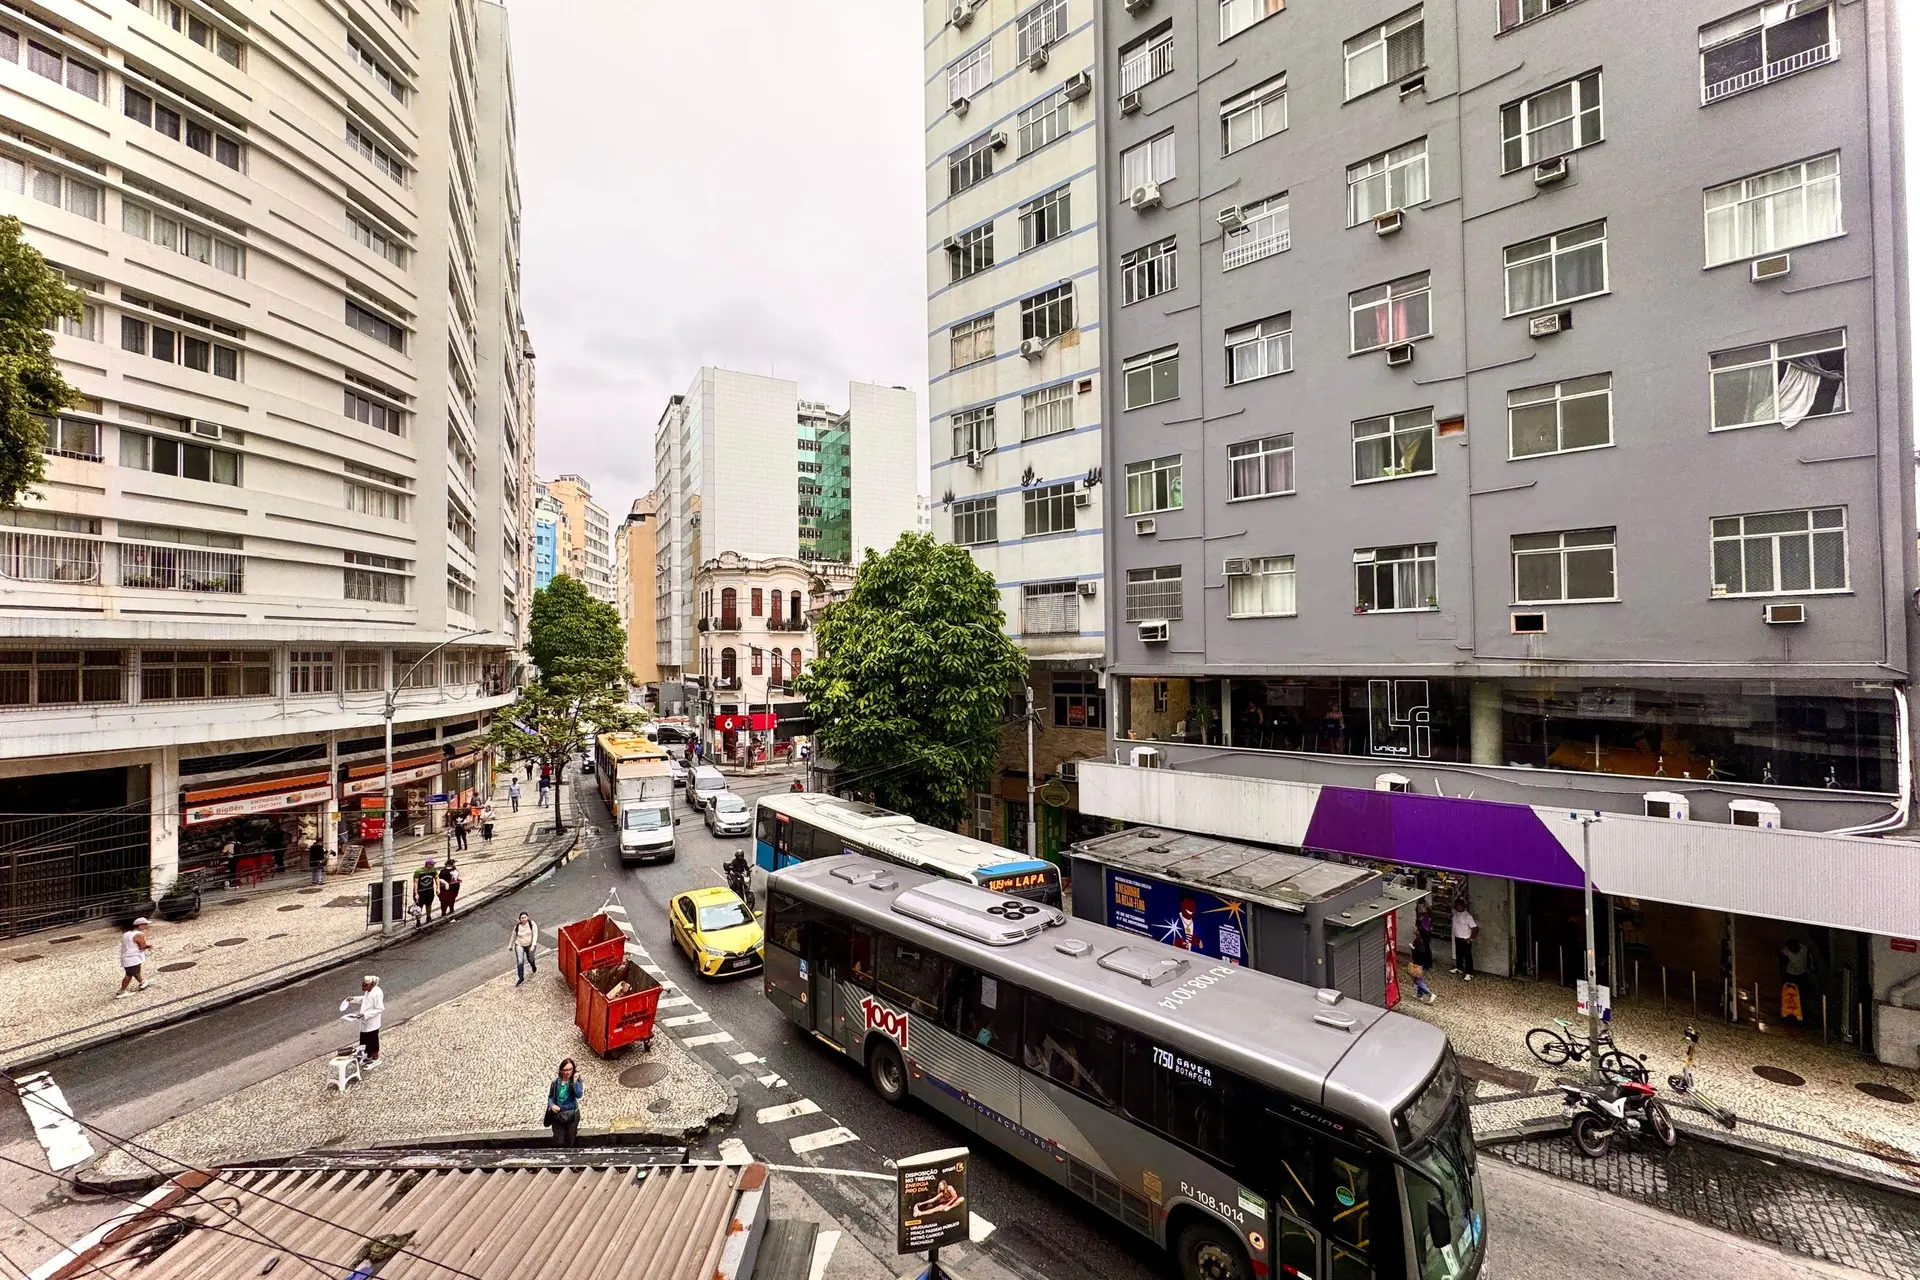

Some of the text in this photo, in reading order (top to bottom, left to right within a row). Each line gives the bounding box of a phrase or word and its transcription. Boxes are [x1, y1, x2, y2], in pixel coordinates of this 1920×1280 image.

[1373, 745, 1408, 755] unique
[1015, 873, 1045, 887] LAPA
[1157, 966, 1236, 1010] RJ 108.1014
[860, 995, 908, 1050] 1001
[1175, 1065, 1213, 1086] BOTAFOGO
[1176, 1057, 1211, 1077] GAVEA
[1289, 1104, 1344, 1131] Torino
[905, 1168, 938, 1179] DISPOSIÇÃO
[1180, 1181, 1194, 1197] RJ
[1196, 1191, 1245, 1224] 108.1014
